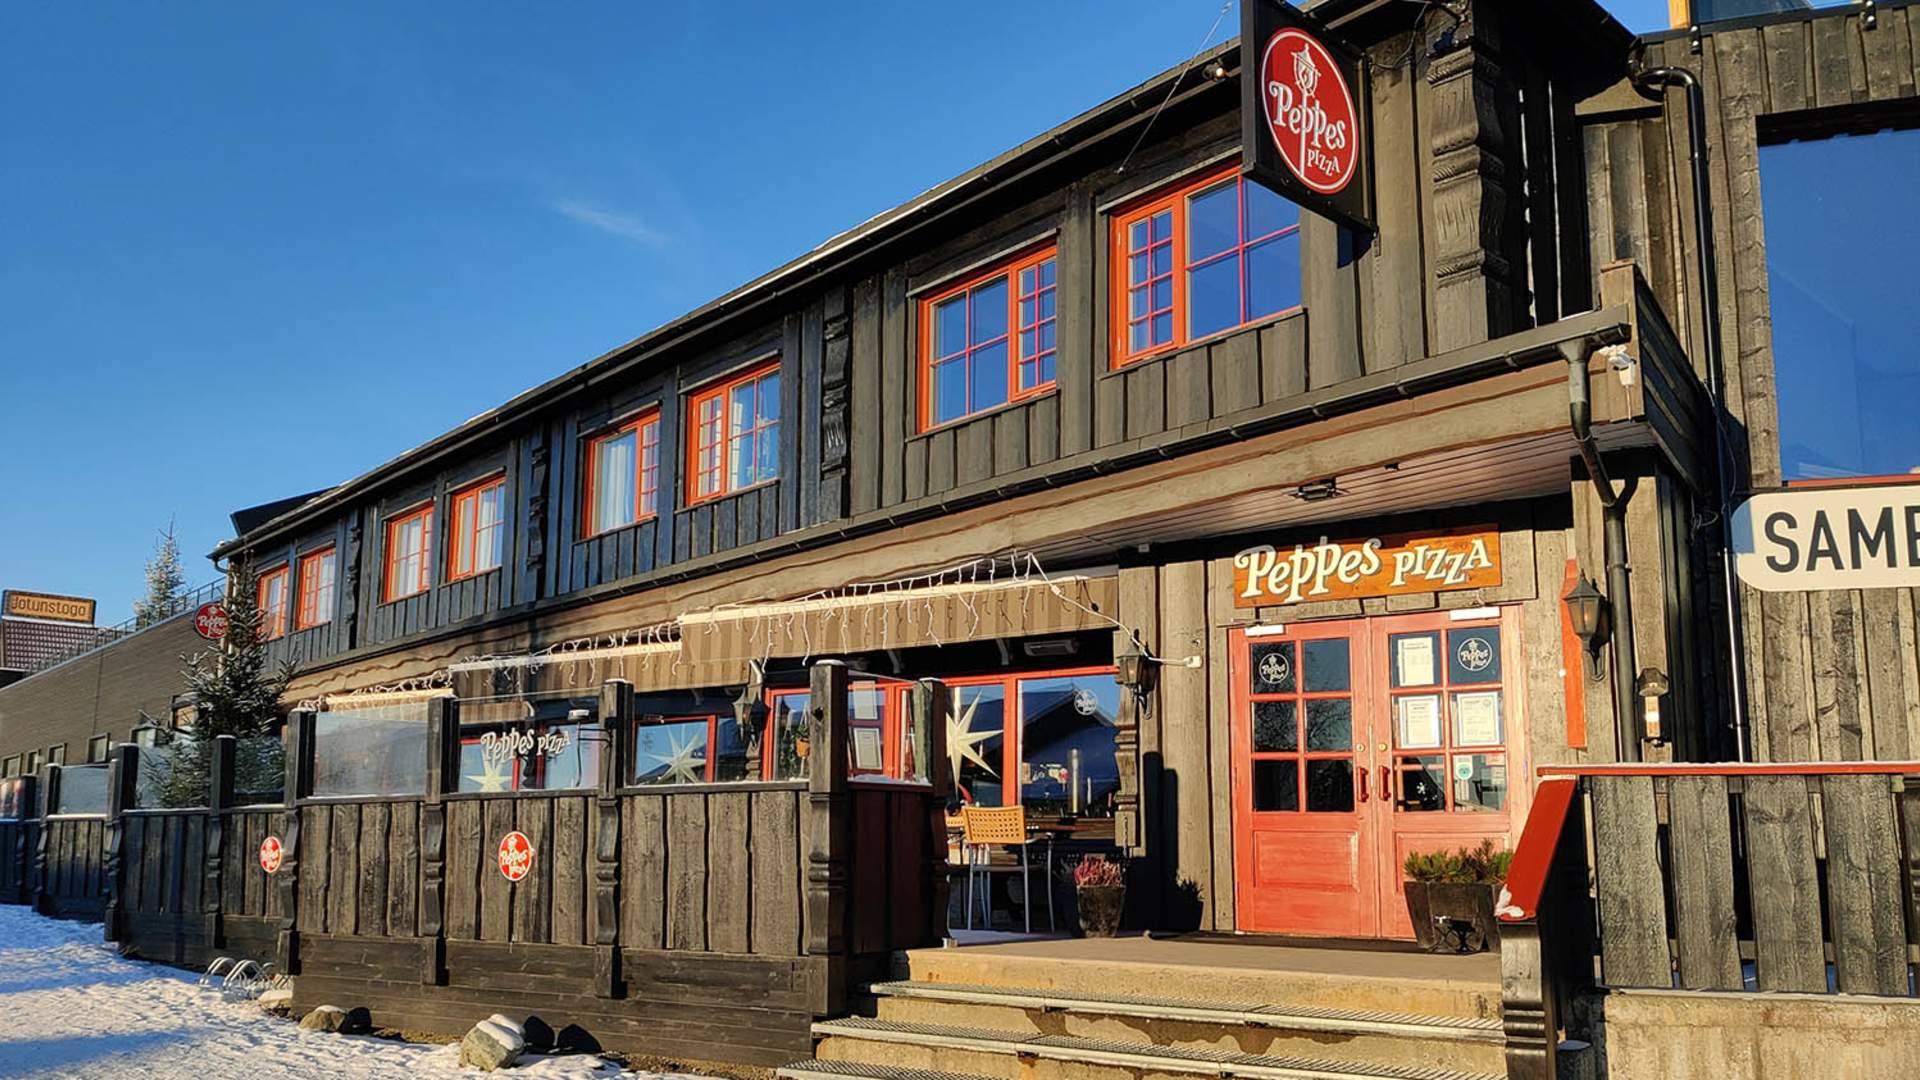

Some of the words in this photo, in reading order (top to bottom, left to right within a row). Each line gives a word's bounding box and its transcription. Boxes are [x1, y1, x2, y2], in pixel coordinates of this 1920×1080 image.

[1269, 81, 1346, 150] Peppes
[1234, 536, 1382, 603] Peppes
[480, 727, 534, 763] Peppes
